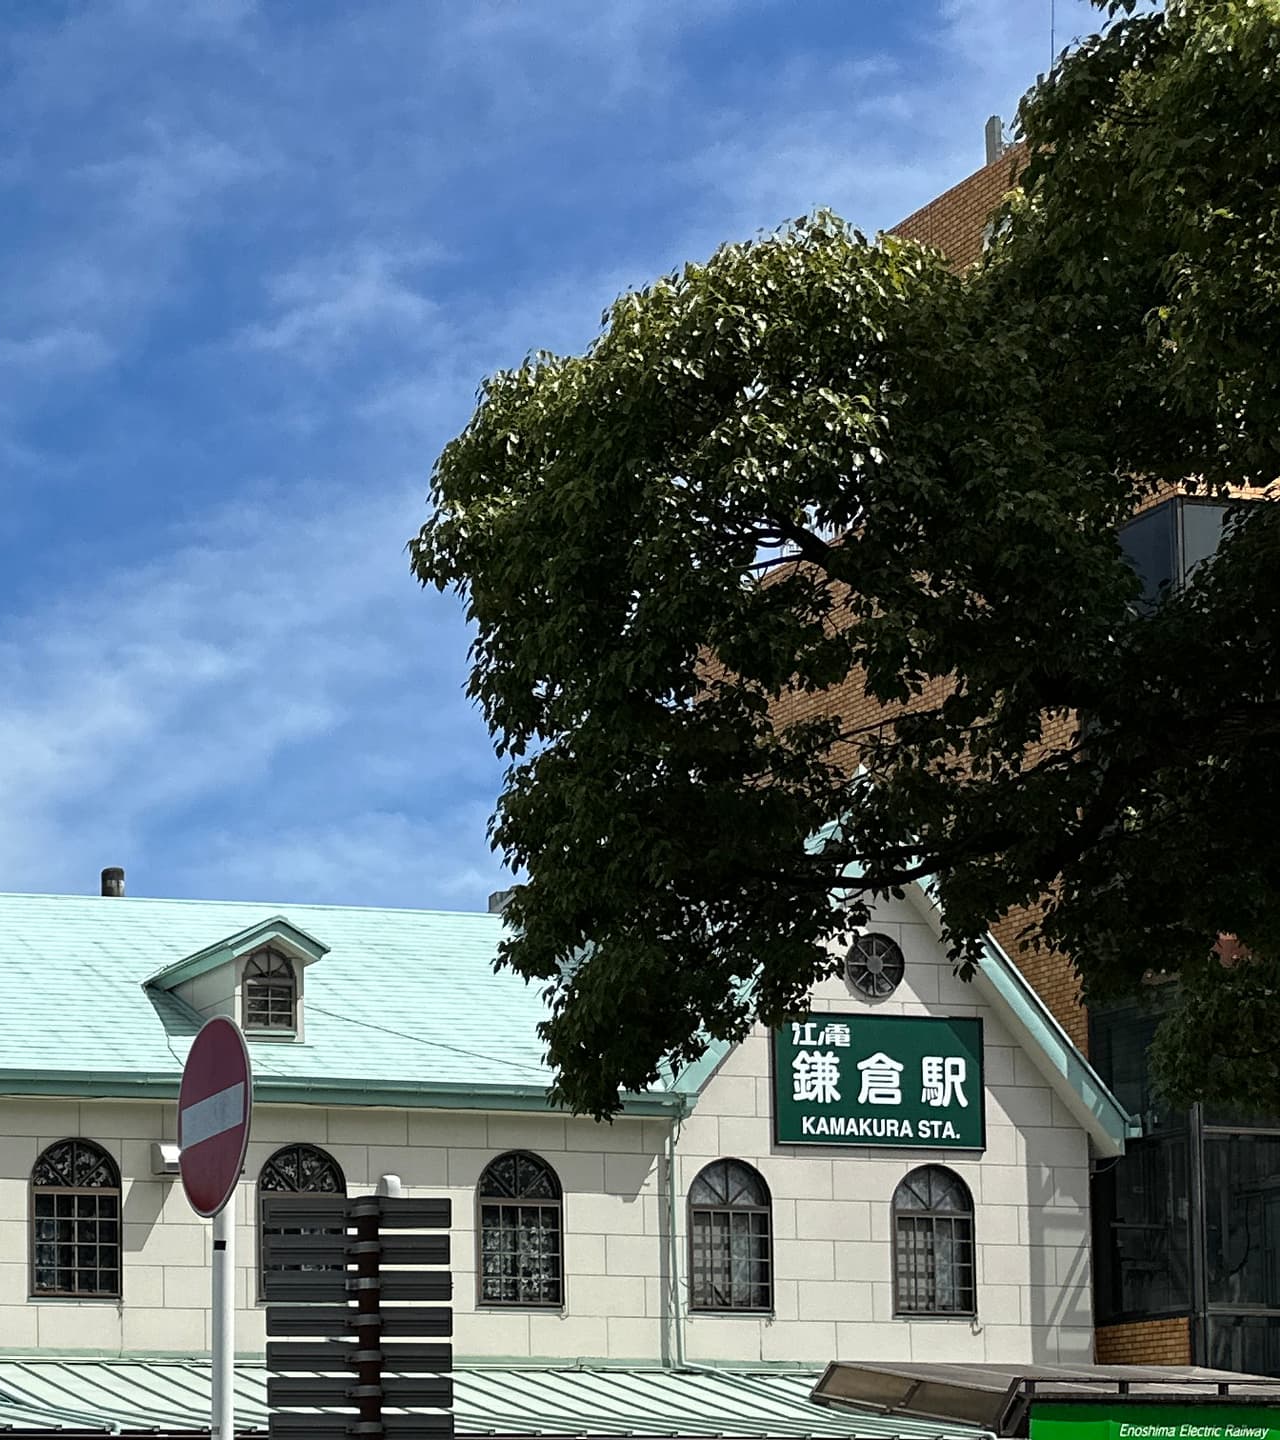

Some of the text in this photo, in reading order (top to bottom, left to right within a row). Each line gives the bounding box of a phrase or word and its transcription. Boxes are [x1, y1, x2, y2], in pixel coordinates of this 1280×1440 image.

[791, 1050, 969, 1108] 鎌倉駅
[802, 1116, 961, 1140] KAMAKURA STA.
[1119, 1423, 1270, 1440] Enoshima Electric Railway
